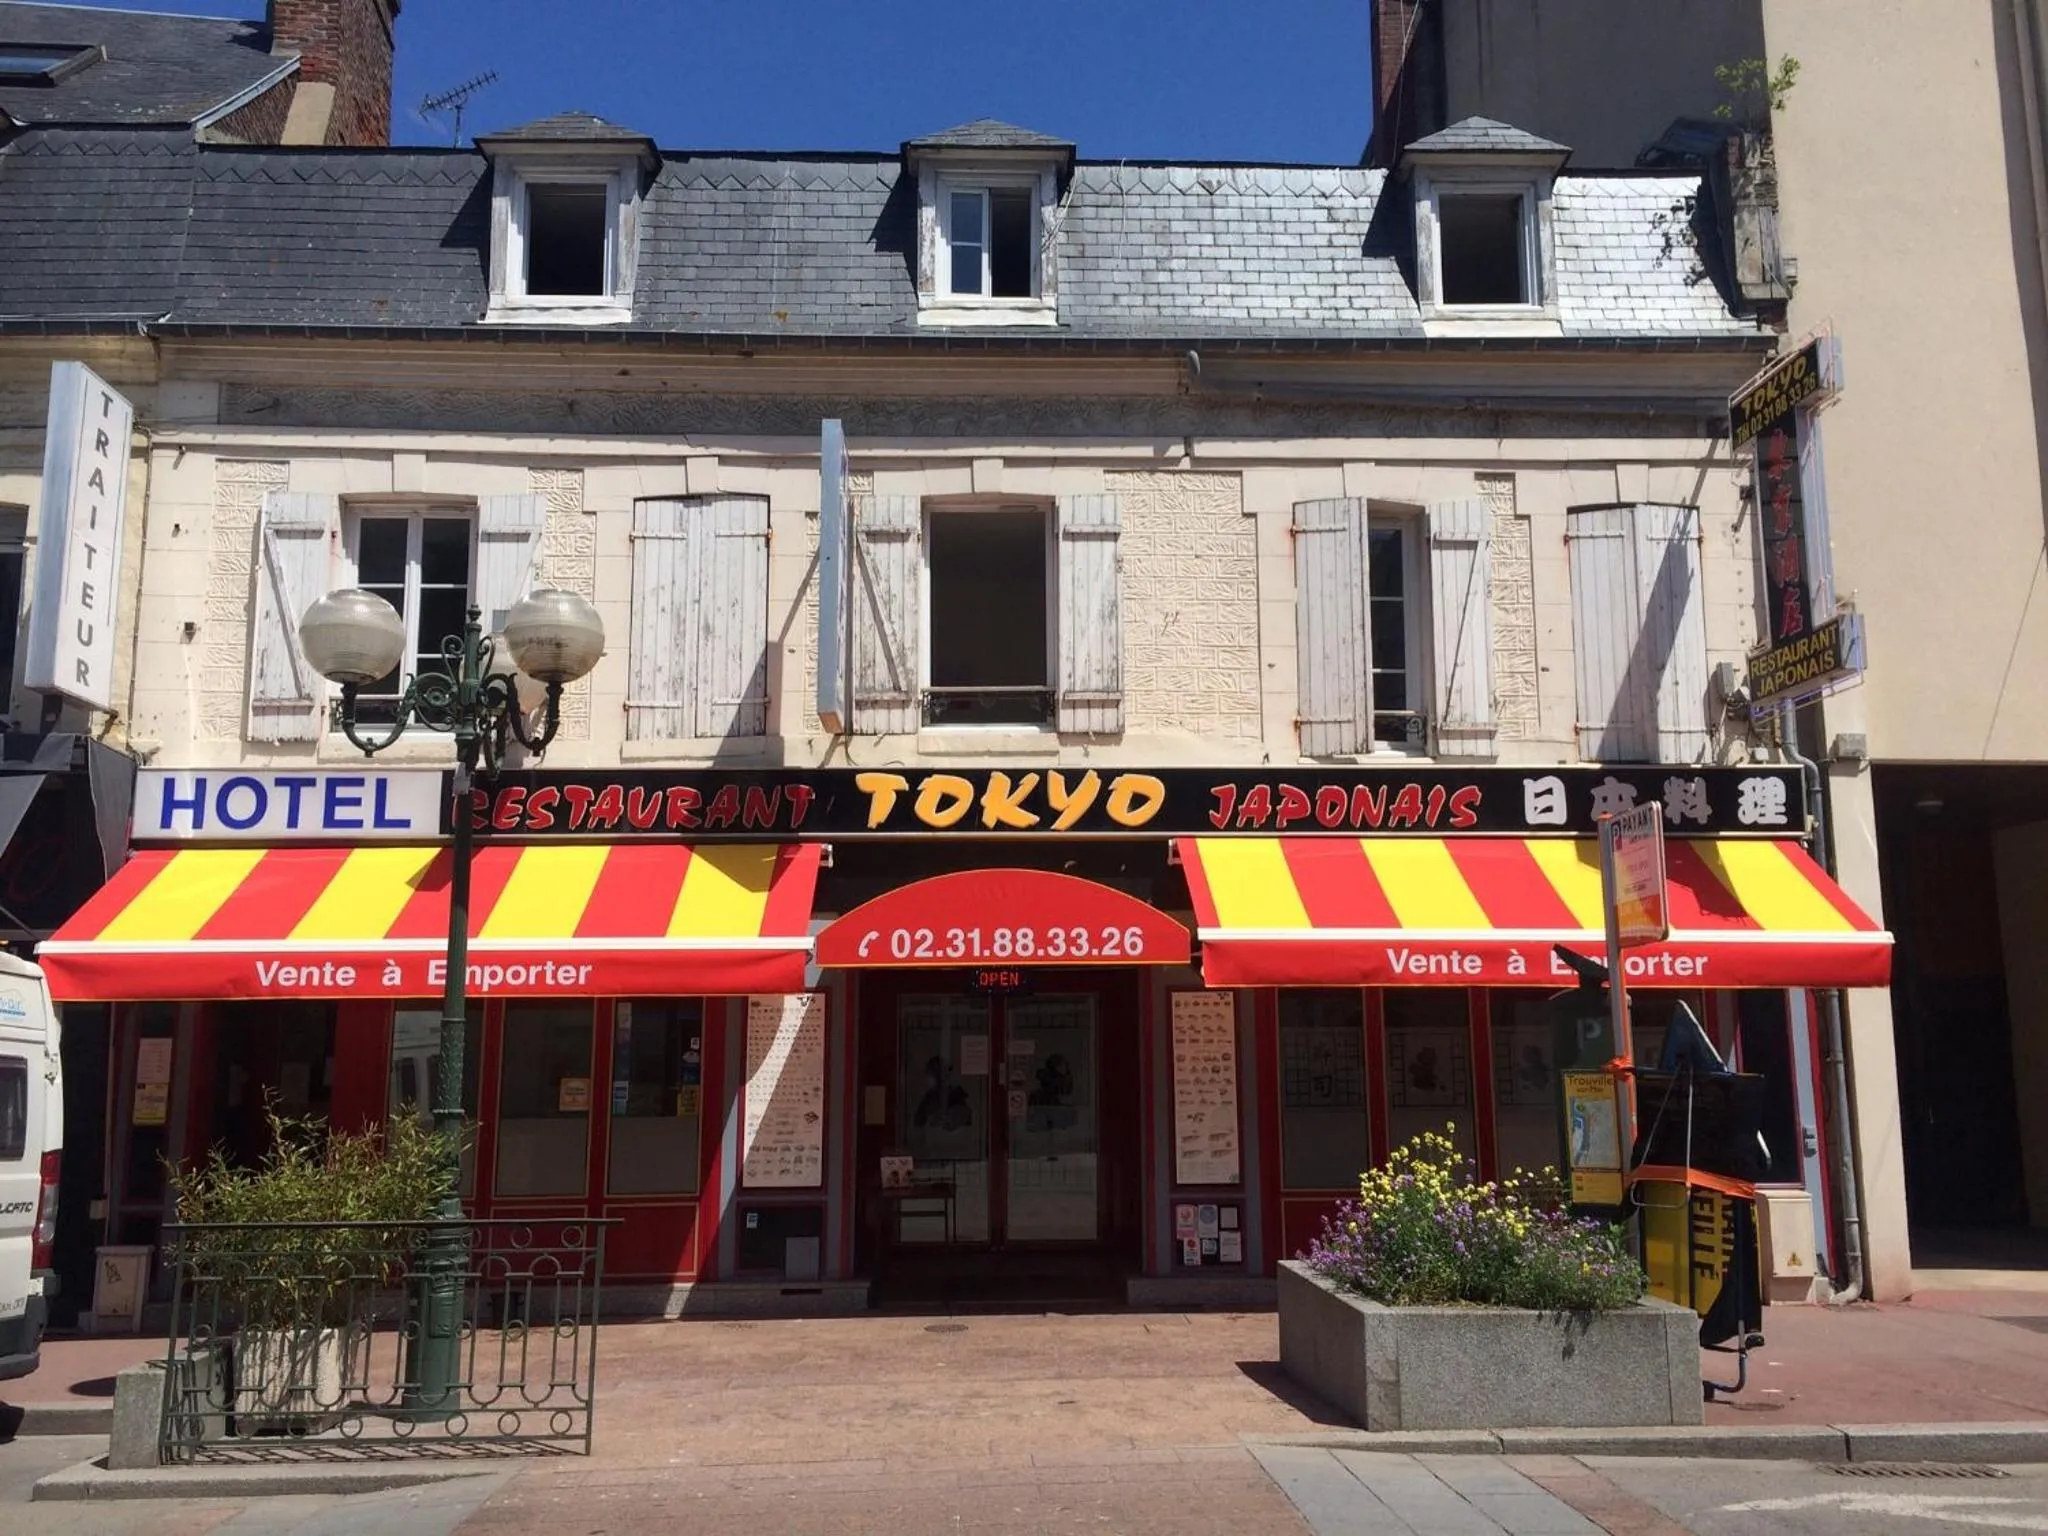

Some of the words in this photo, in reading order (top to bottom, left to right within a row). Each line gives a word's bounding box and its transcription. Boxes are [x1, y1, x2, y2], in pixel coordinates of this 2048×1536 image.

[1741, 356, 1807, 418] TOKYO
[75, 391, 113, 687] TRAITEUR
[1751, 625, 1838, 680] RESTAURANT
[1756, 650, 1835, 697] JAPONAIS
[159, 776, 411, 830] HOTEL
[855, 771, 1166, 831] TOKYO
[1209, 783, 1483, 831] JAPONAIS
[1523, 775, 1789, 825] 日本料理
[891, 926, 1144, 959] 02.31.88.33.26
[1387, 949, 1482, 976] Vente
[1507, 946, 1527, 976] à
[1550, 950, 1709, 986] Eorter
[256, 961, 356, 988] Vente
[382, 957, 402, 987] à
[979, 971, 1019, 986] OPEN
[1568, 1075, 1614, 1087] Trouville
